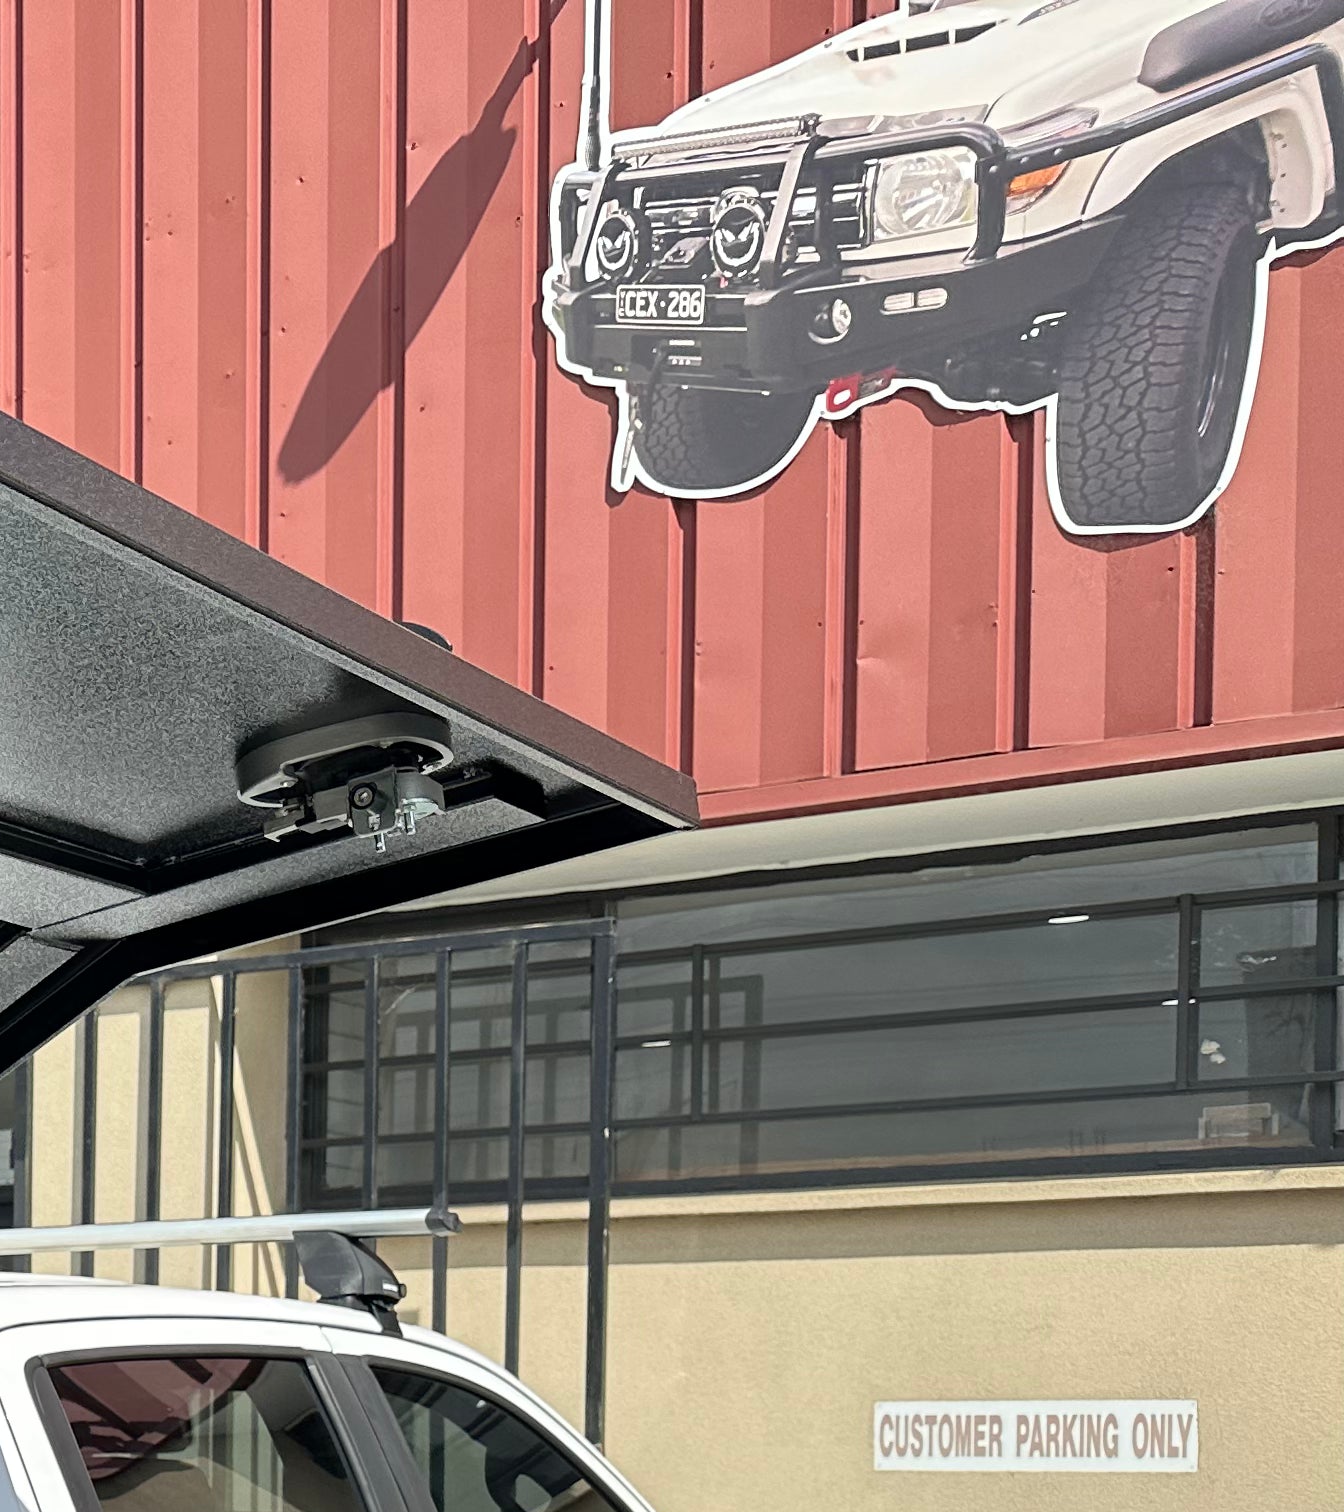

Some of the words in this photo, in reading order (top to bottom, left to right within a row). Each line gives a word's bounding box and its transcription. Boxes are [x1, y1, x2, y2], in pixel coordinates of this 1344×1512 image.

[879, 1413, 1002, 1458] CUSTOMER
[1015, 1413, 1119, 1459] PARKING
[1131, 1413, 1194, 1459] ONLY
